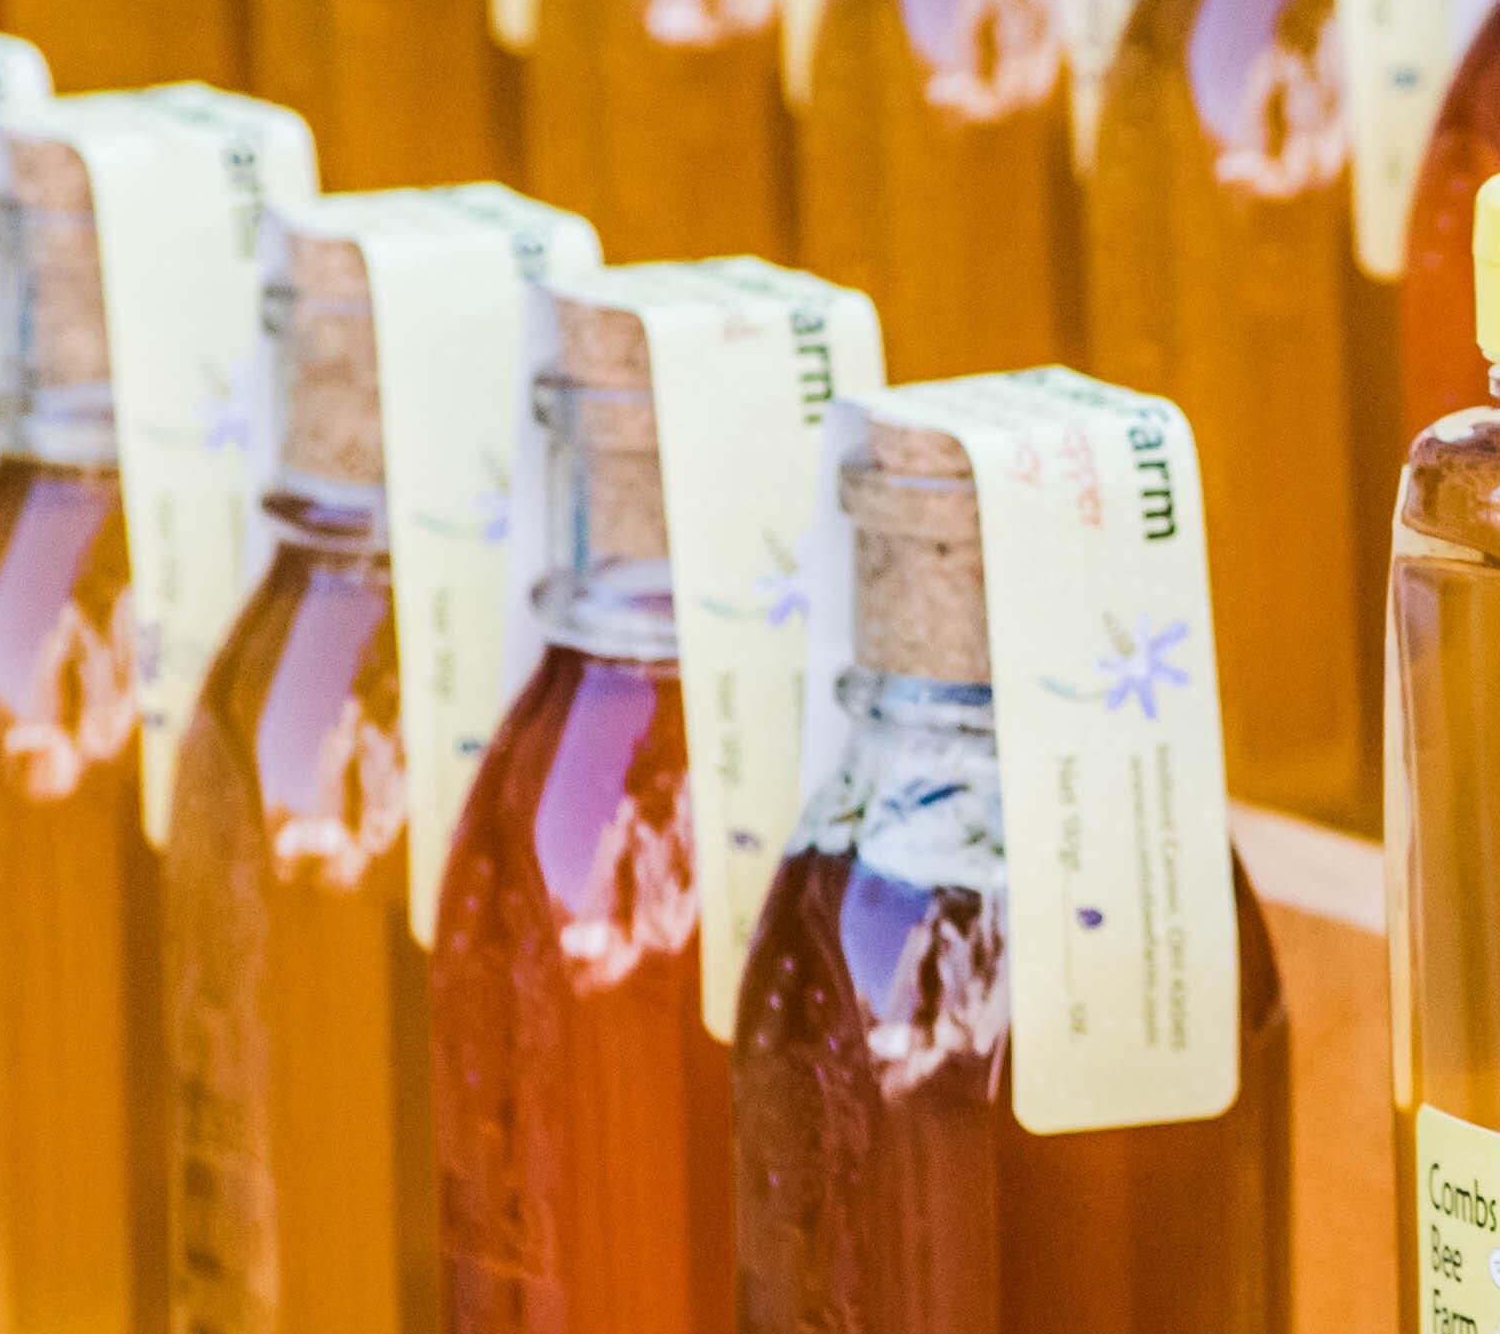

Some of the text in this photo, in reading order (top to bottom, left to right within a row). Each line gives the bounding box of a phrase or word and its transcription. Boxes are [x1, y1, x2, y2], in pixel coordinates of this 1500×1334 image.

[785, 303, 832, 429] arm
[1428, 1162, 1497, 1234] Combs
[1431, 1223, 1462, 1283] Bee
